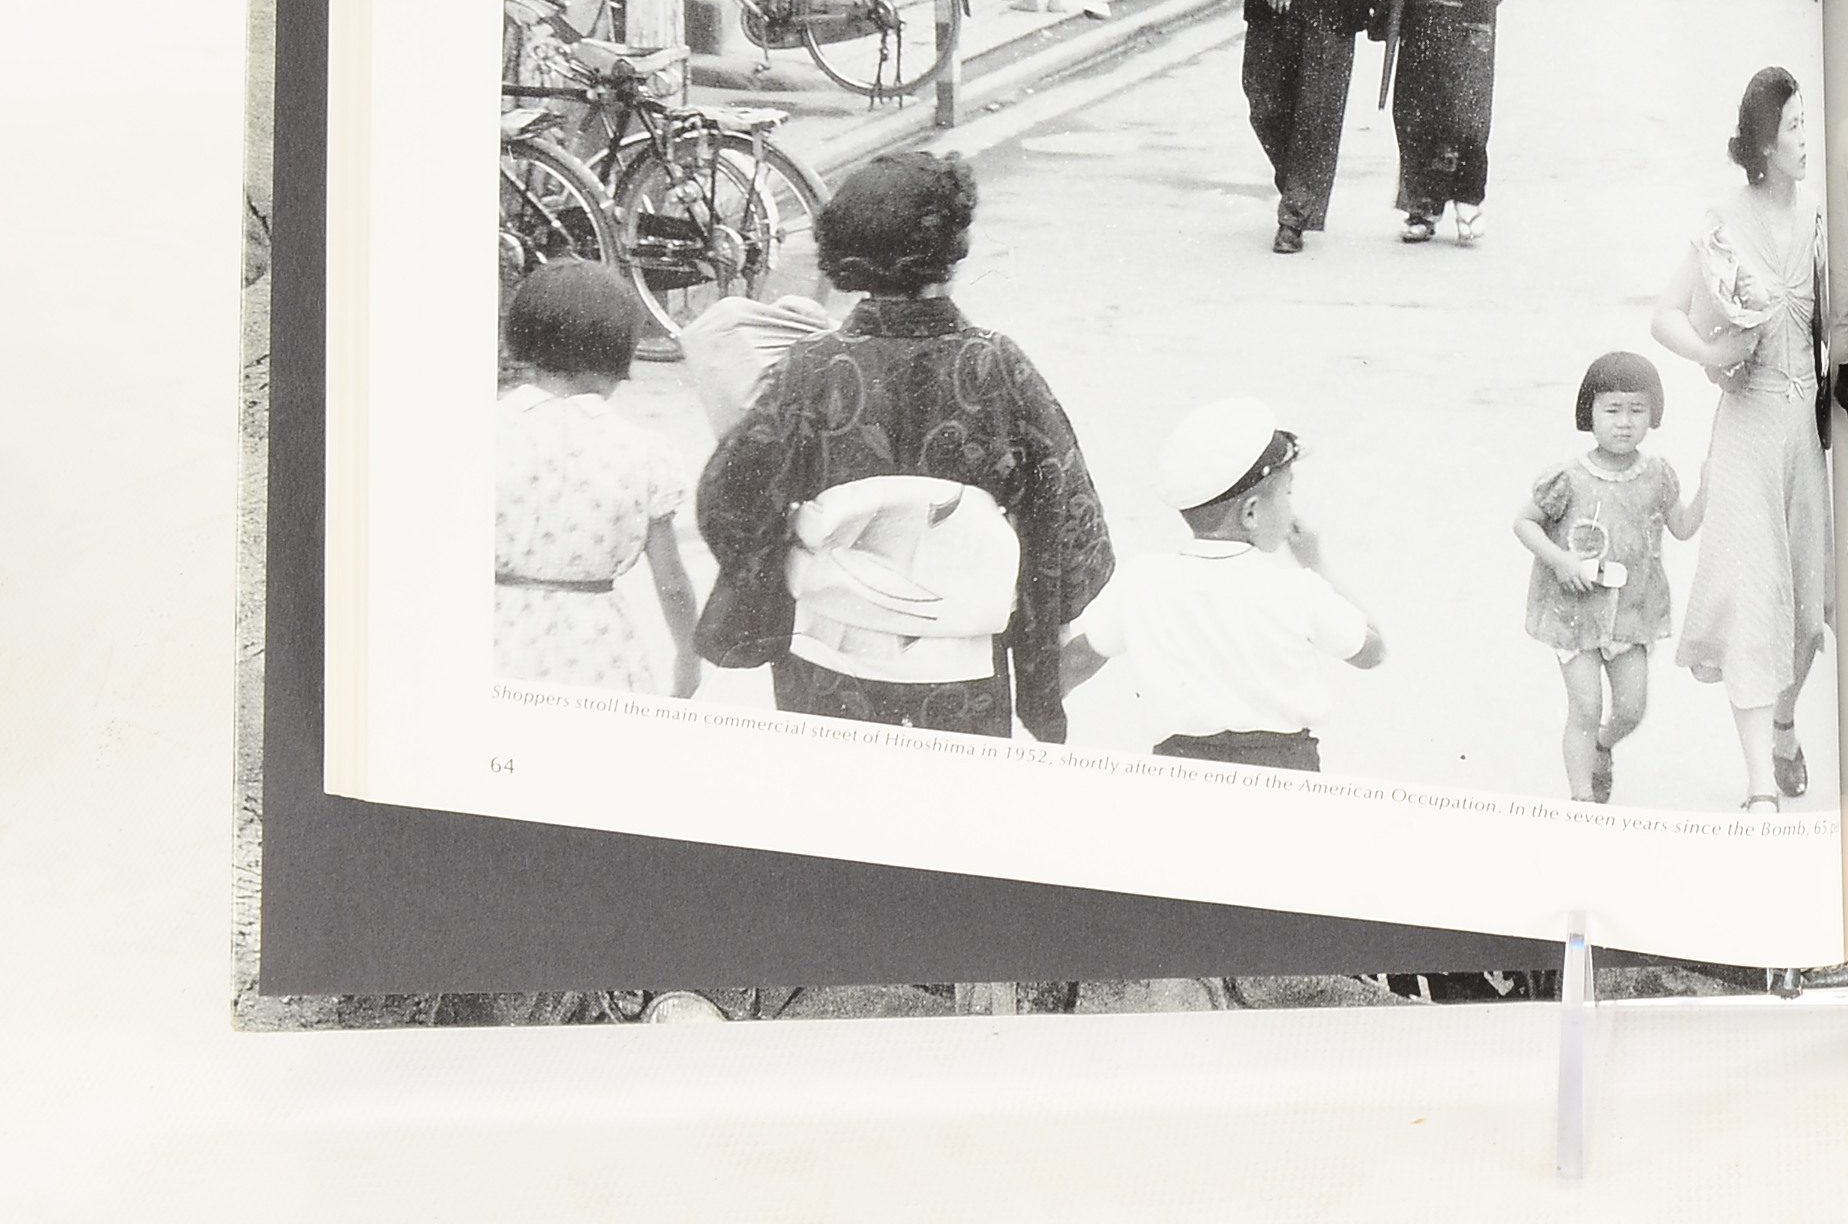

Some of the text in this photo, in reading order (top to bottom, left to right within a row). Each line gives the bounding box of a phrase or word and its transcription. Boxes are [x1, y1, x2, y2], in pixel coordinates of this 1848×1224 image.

[490, 756, 515, 775] 64
[491, 683, 570, 708] Shoppers
[576, 694, 618, 713] stroll
[624, 700, 650, 718] the
[655, 706, 698, 723] main
[704, 711, 806, 736] commercial
[811, 723, 858, 743] street
[862, 729, 881, 744] of
[885, 731, 975, 757] Hiroshima
[981, 742, 998, 758] in
[1005, 745, 1053, 767] 1952,
[1060, 752, 1120, 775] shortly
[1125, 760, 1164, 778] after
[1170, 765, 1199, 781] the
[1204, 768, 1237, 786] end
[1242, 771, 1261, 787] of
[1265, 775, 1294, 792] the
[1299, 778, 1385, 802] American
[1391, 787, 1502, 815] Occupation.
[1509, 802, 1525, 817] In
[1531, 803, 1560, 821] the
[1565, 810, 1617, 827] seven
[1621, 816, 1668, 834] years
[1674, 818, 1722, 836] since
[1727, 819, 1755, 837] the
[1760, 820, 1810, 838] Bomb,
